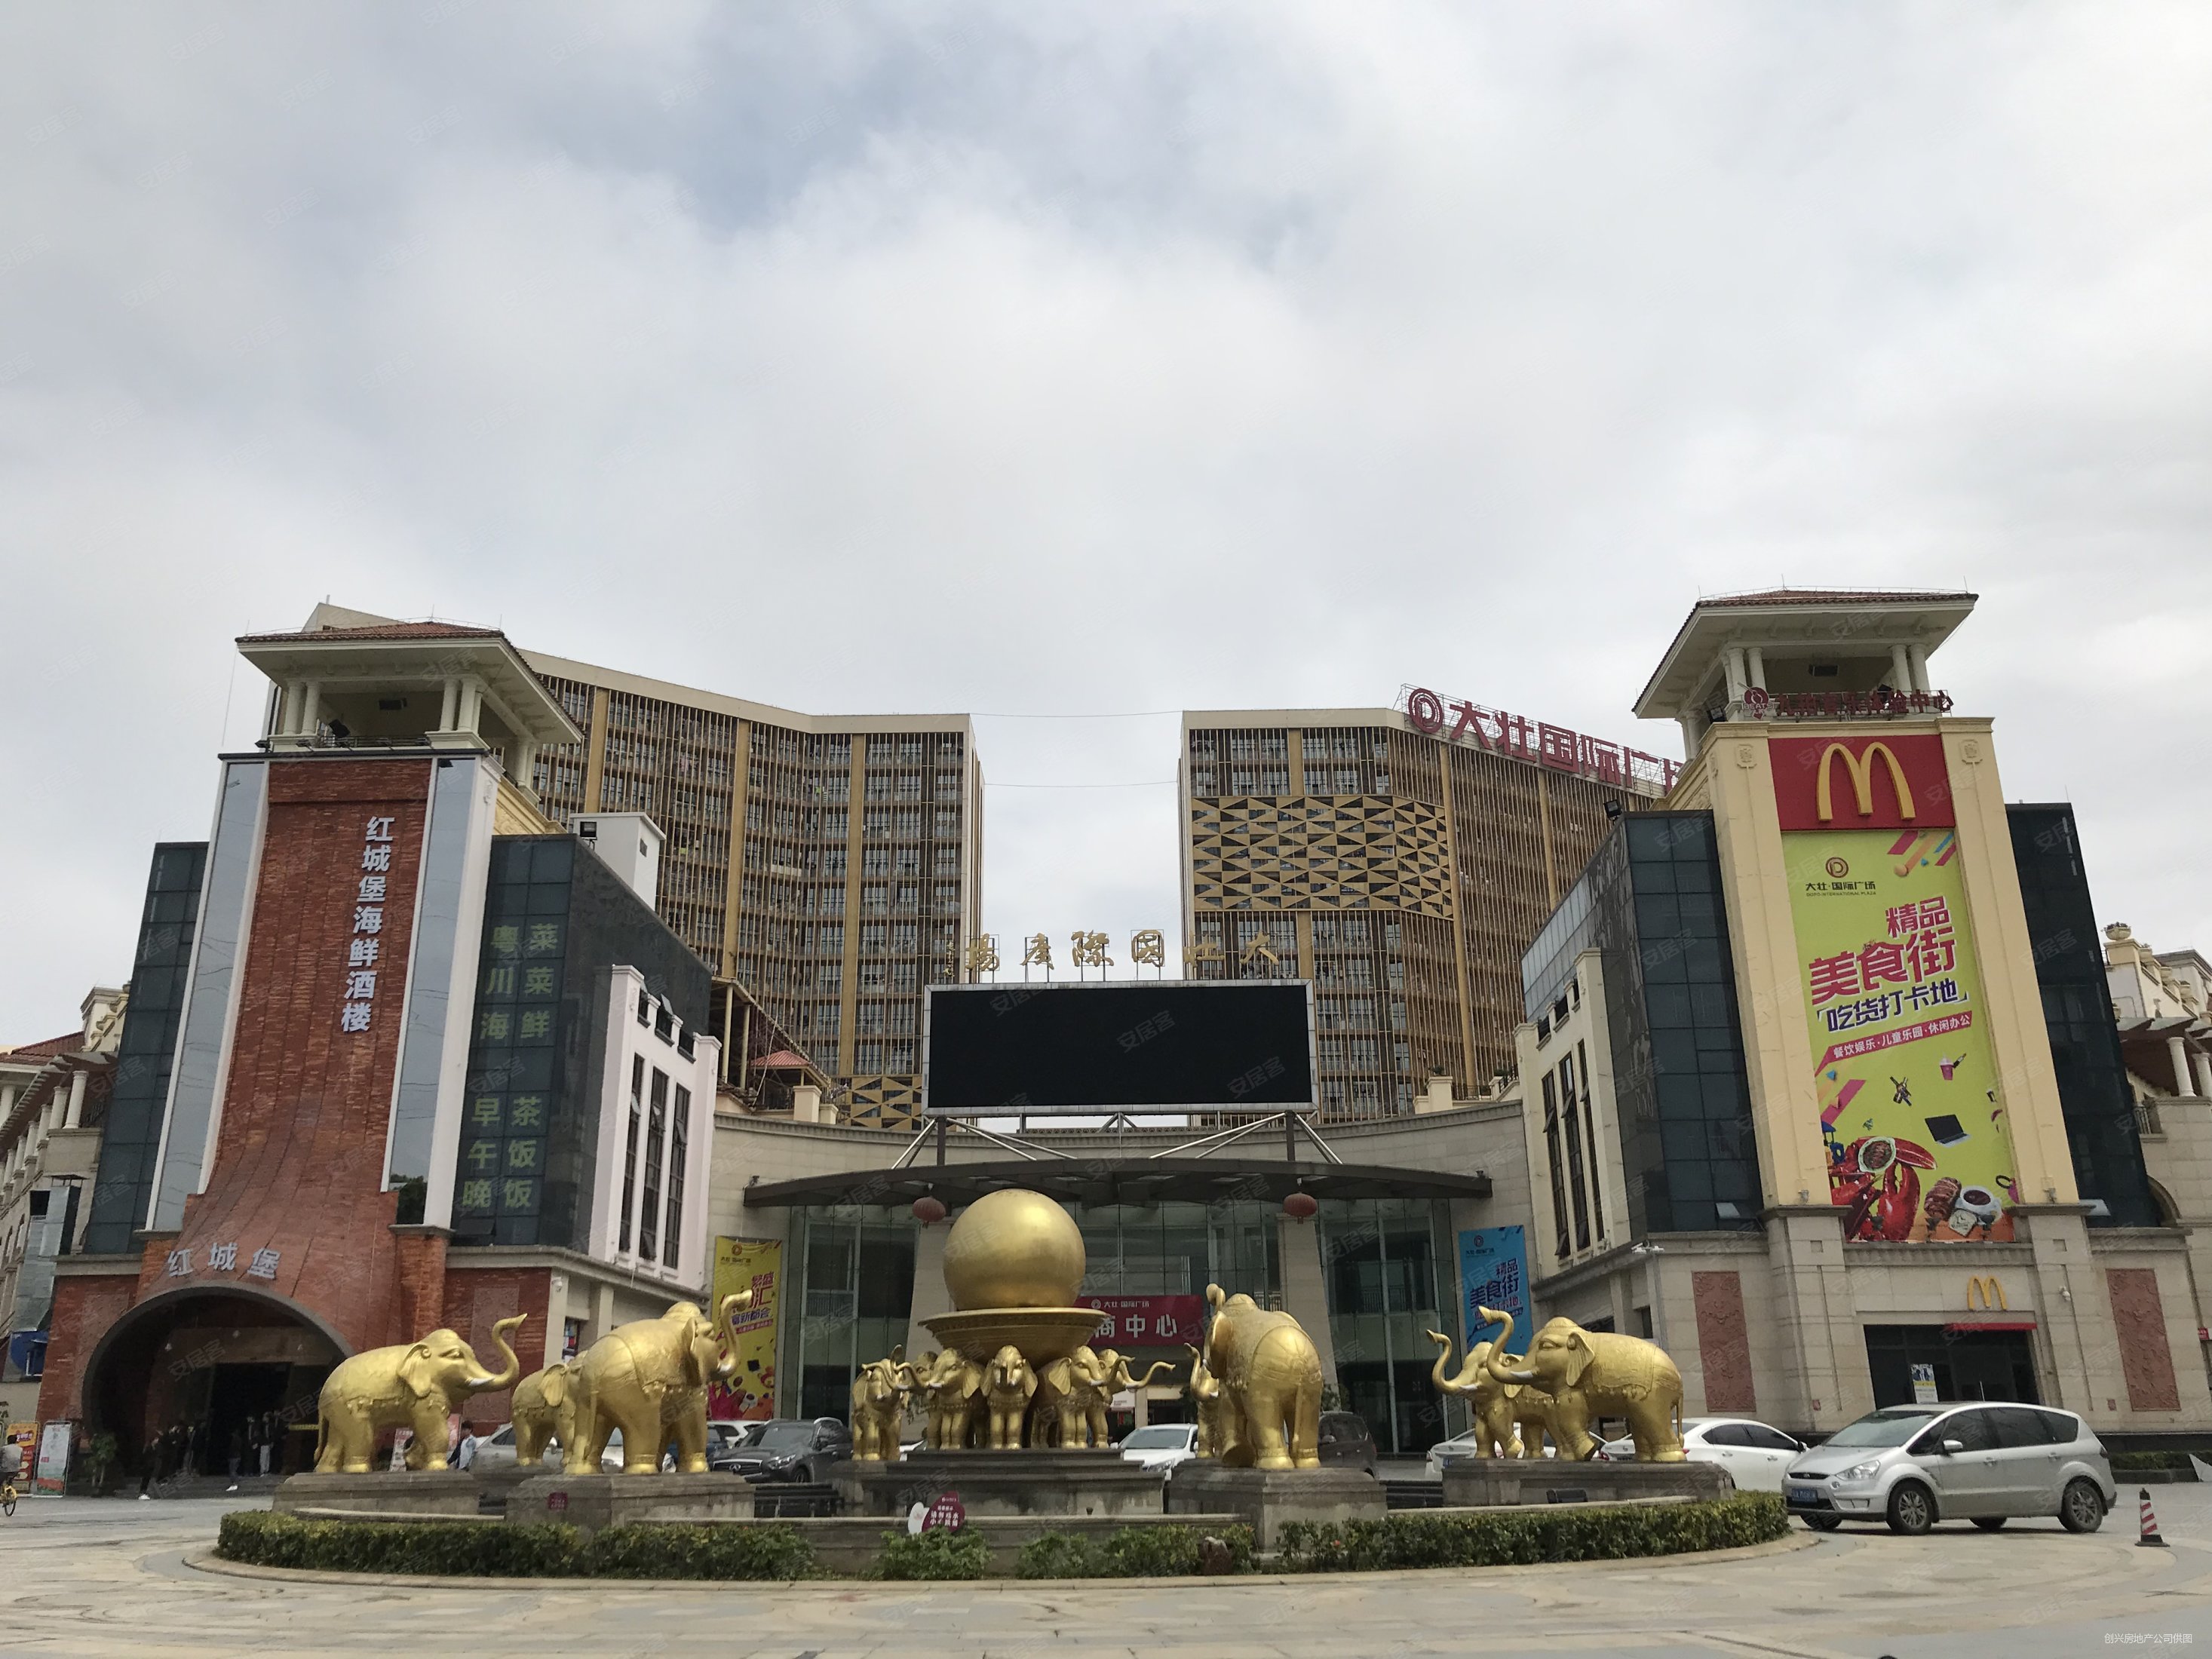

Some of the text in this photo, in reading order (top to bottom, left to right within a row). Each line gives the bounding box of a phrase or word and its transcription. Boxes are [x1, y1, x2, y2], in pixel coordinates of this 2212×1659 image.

[340, 815, 395, 1033] 红城堡海鲜酒楼
[1885, 895, 1951, 939] 精品
[491, 923, 559, 953] 粤菜
[485, 967, 555, 996] 川菜
[1809, 926, 1956, 1006] 美食街
[480, 1010, 551, 1040] 海鲜
[471, 1096, 542, 1127] 早茶
[468, 1139, 538, 1168] 午饭
[462, 1179, 532, 1209] 晚饭
[167, 1241, 282, 1279] 红城堡
[1469, 1271, 1520, 1309] 美食街
